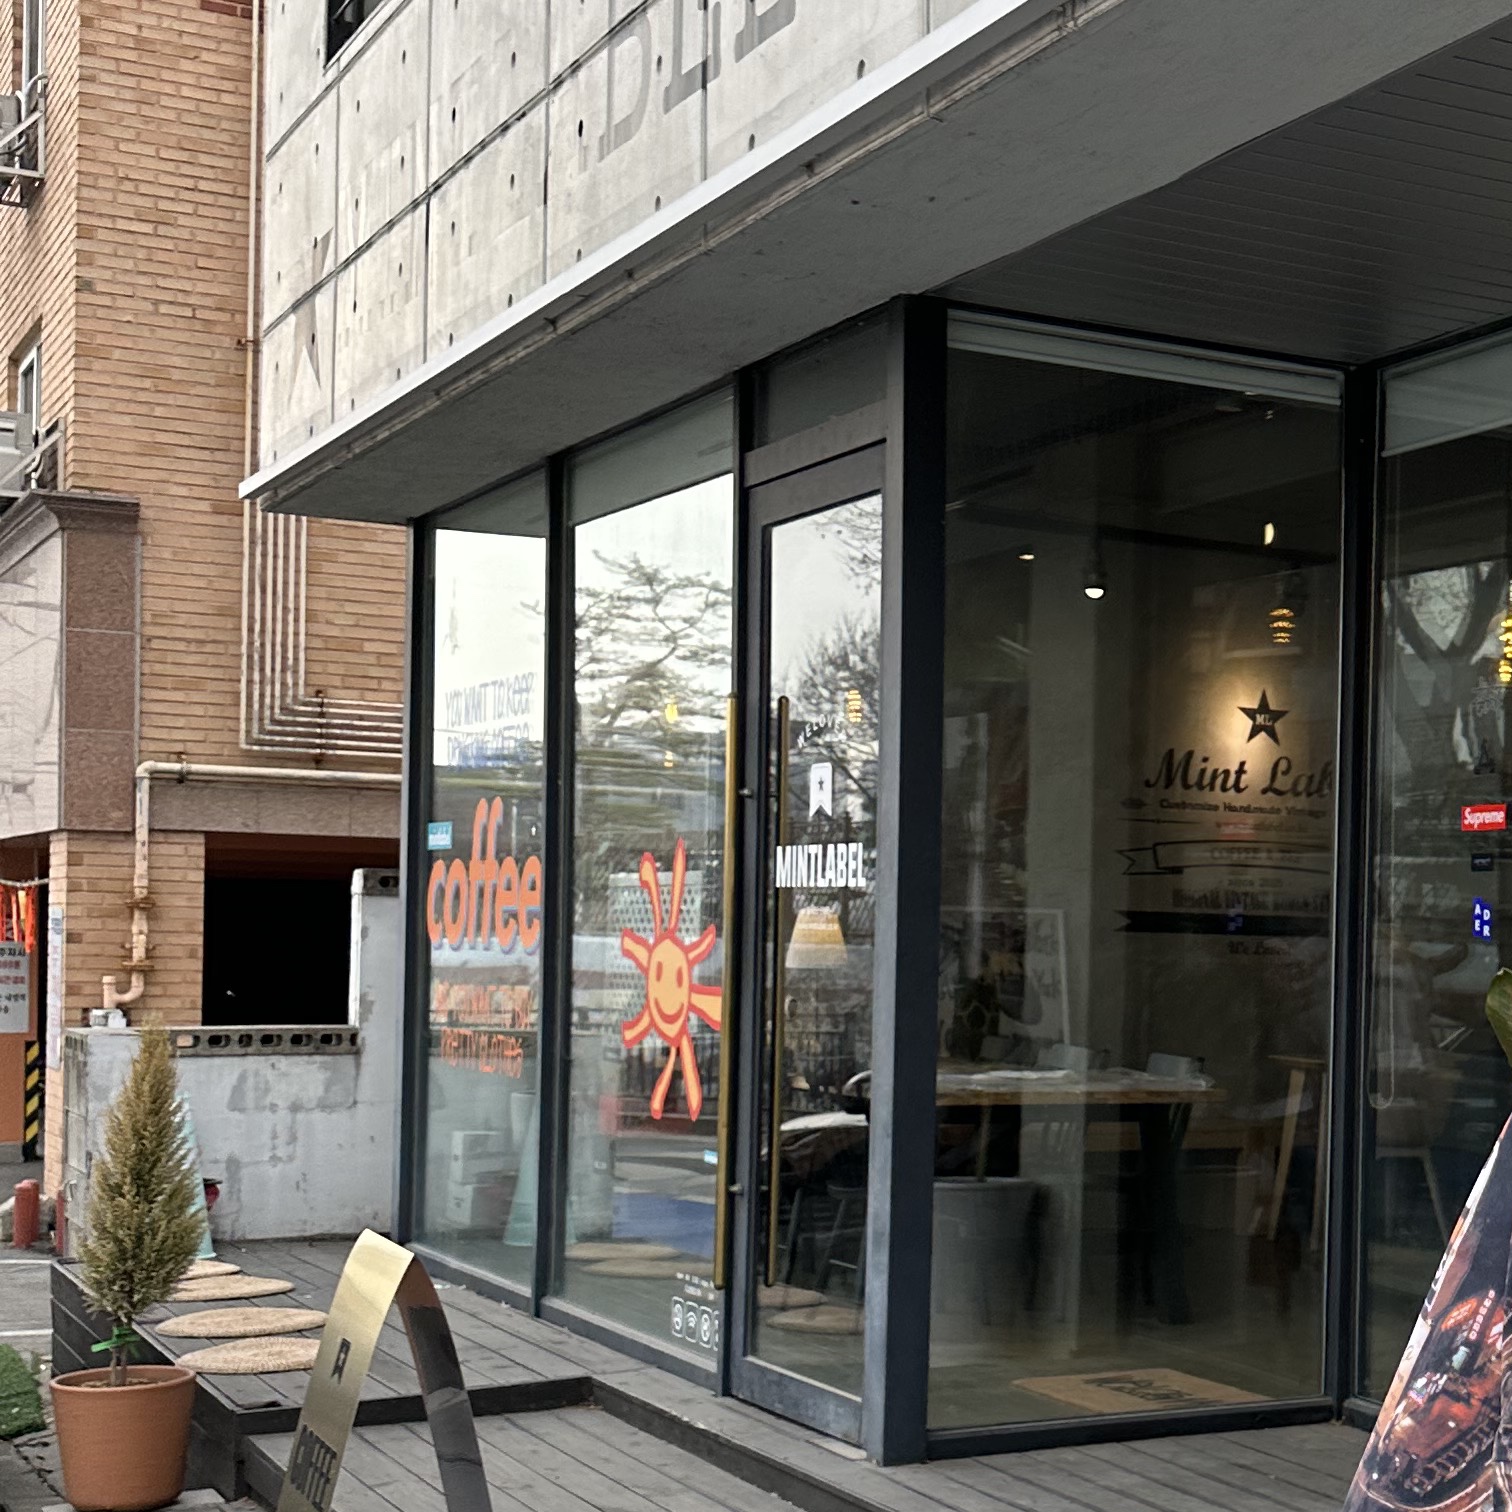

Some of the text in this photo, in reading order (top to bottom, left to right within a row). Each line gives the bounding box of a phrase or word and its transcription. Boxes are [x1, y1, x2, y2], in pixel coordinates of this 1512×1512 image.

[1255, 713, 1272, 726] ML
[1145, 747, 1249, 794] Mint
[1464, 807, 1504, 829] Supreme
[426, 796, 541, 953] coffee
[775, 842, 866, 888] MINTLABEL
